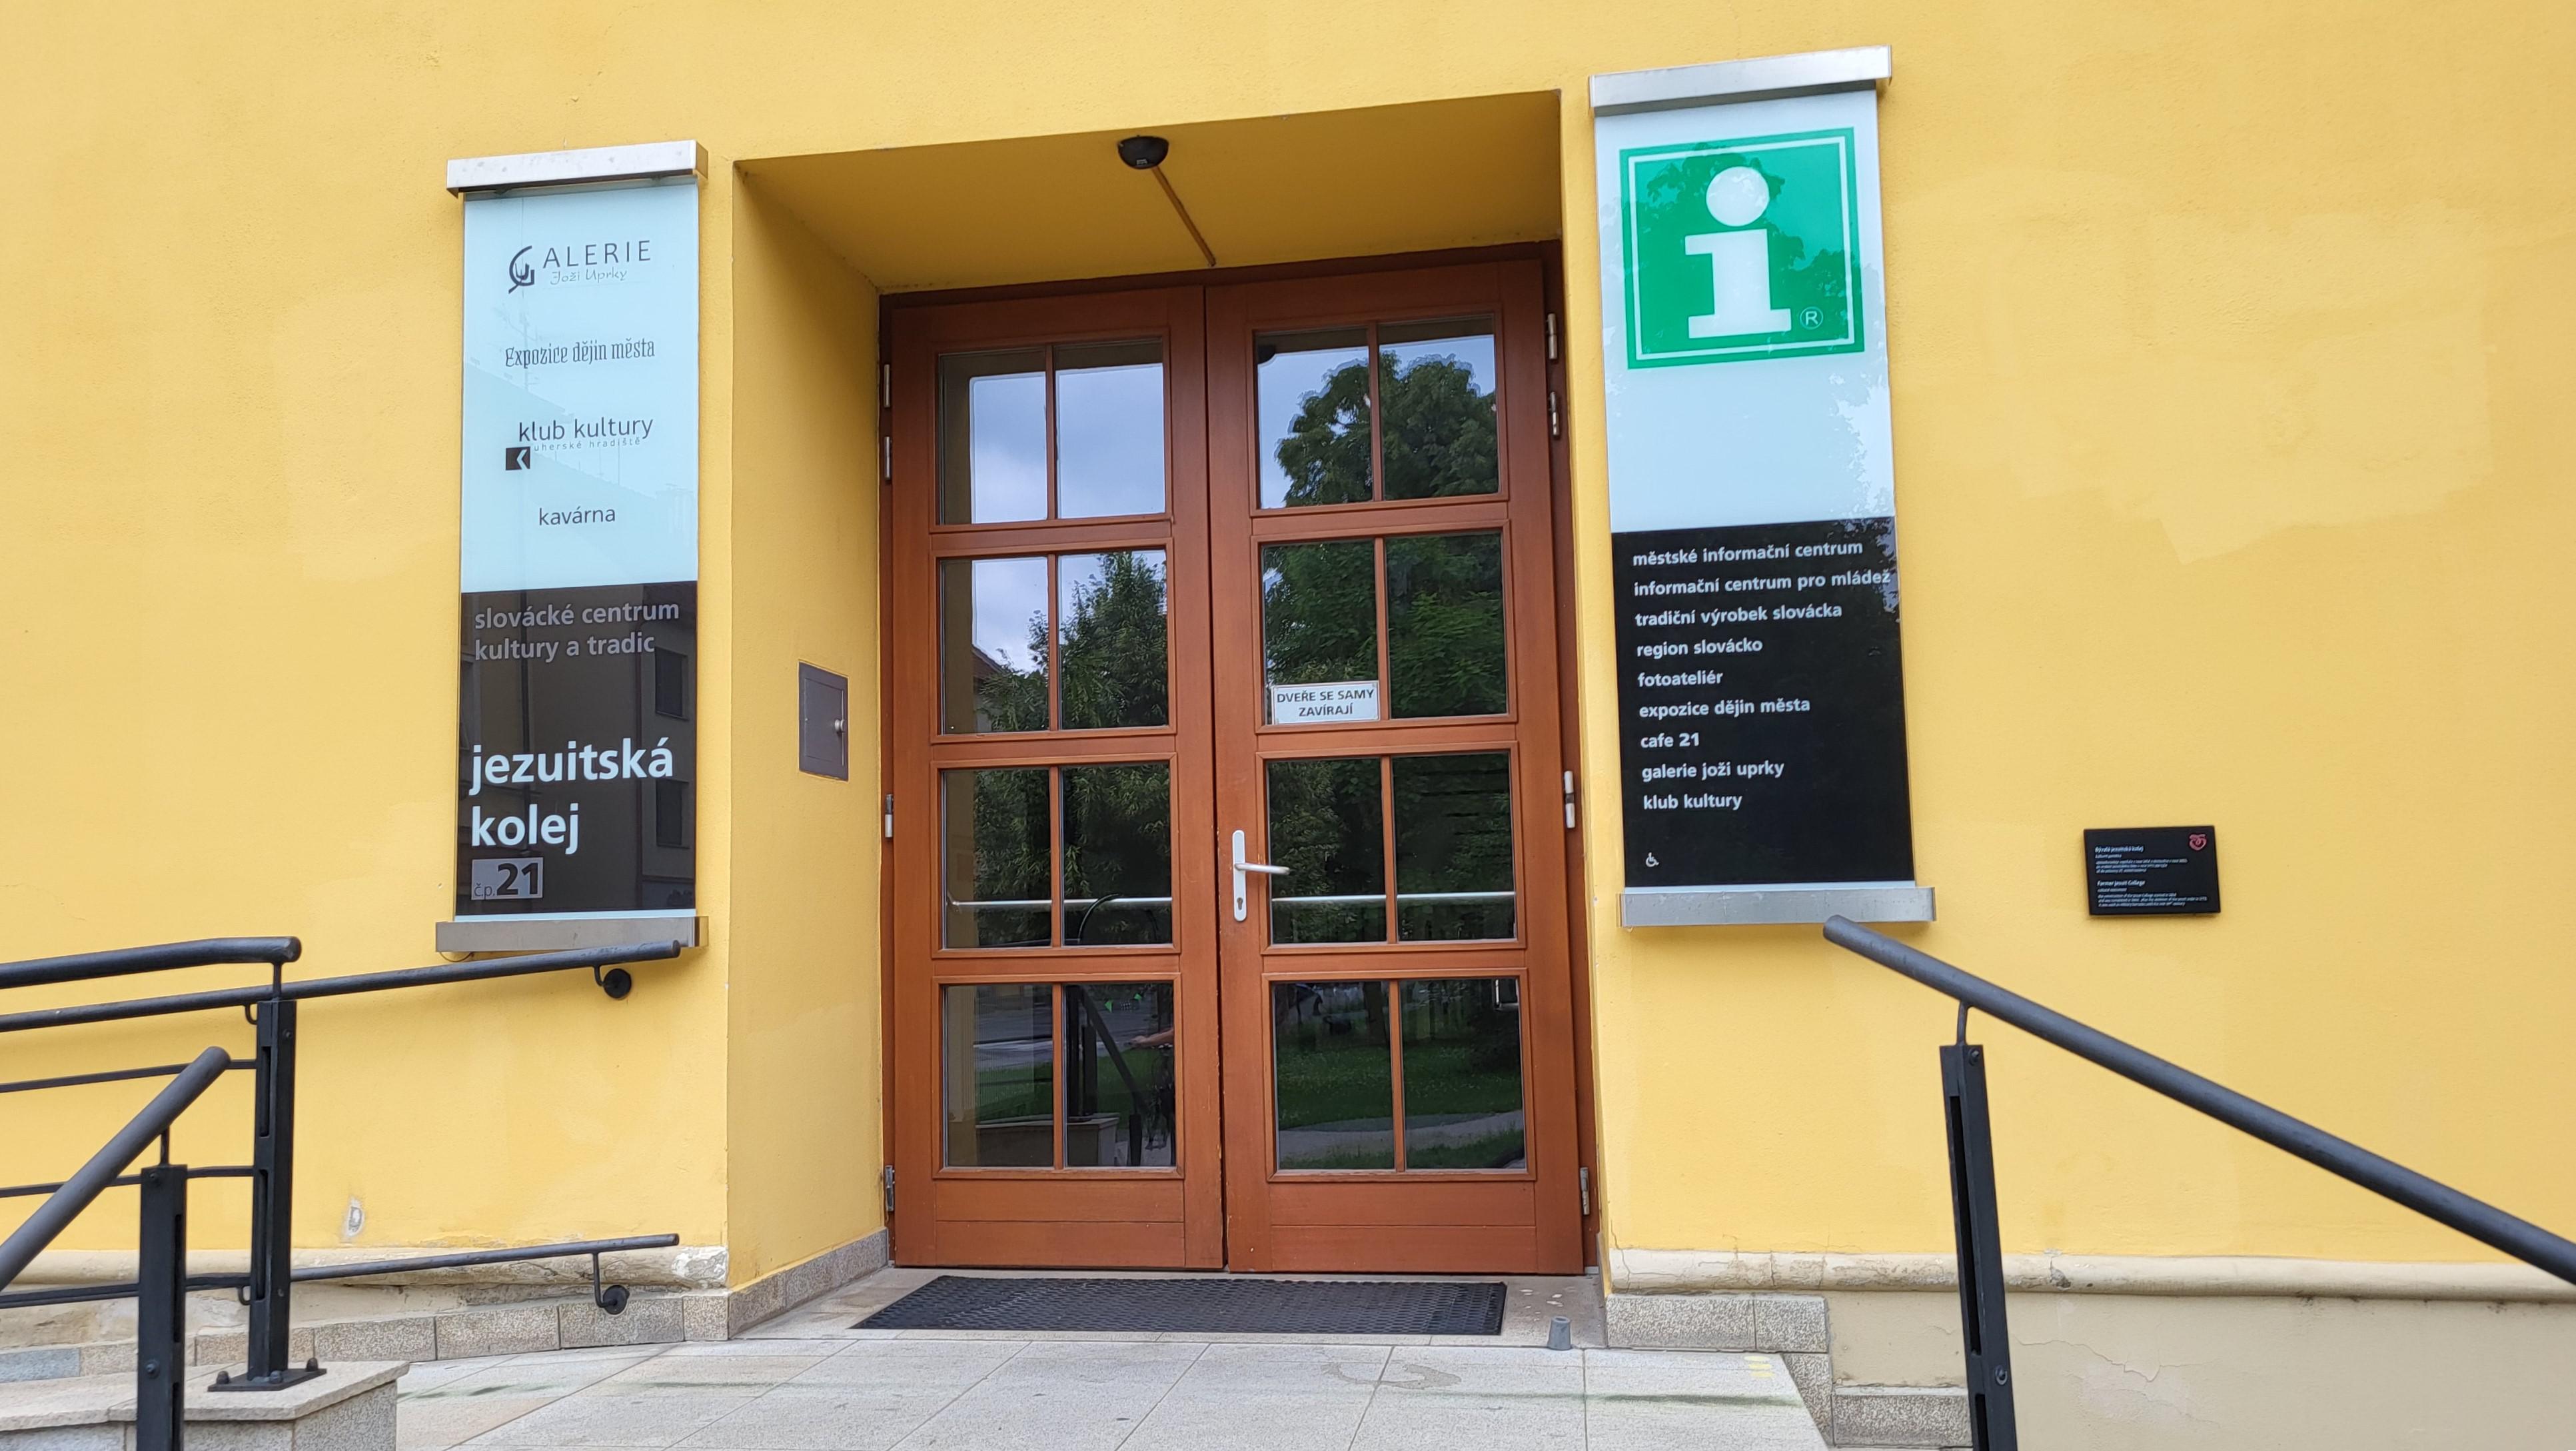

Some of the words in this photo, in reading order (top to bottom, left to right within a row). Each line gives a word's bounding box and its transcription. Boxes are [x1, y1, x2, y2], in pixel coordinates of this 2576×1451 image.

[585, 267, 627, 283] Uprky
[505, 343, 568, 369] Expozice
[572, 340, 607, 365] dějin
[612, 338, 655, 360] města
[519, 421, 566, 442] klub
[574, 417, 654, 439] kultury
[534, 441, 582, 451] uherské
[589, 437, 641, 449] hradiště
[539, 506, 616, 526] kavárna
[1632, 549, 1698, 567] městské
[1703, 542, 1790, 563] informační
[1795, 543, 1863, 558] centrum
[1634, 579, 1720, 596] informační
[1724, 576, 1792, 591] centrum
[1797, 573, 1826, 591] pro
[1831, 569, 1890, 587] mládež
[474, 604, 574, 629] slovácké
[582, 603, 680, 625] centrum
[1635, 610, 1696, 626] tradiční
[1700, 606, 1768, 626] výrobek
[1772, 604, 1842, 621] slovácka
[475, 638, 558, 663] kultury
[566, 642, 580, 656] a
[587, 631, 655, 655] tradic
[1636, 641, 1688, 659] region
[1694, 639, 1763, 654] slovácko
[1637, 671, 1723, 687] fotoateliér
[1277, 690, 1315, 703] DVEŘE
[1320, 691, 1334, 701] SE
[1338, 689, 1374, 699] SAMY
[1299, 703, 1353, 717] ZAVÍRAJÍ
[1639, 702, 1709, 719] expozice
[1714, 700, 1754, 718] dějin
[1760, 698, 1810, 713] města
[1640, 734, 1674, 748] cafe
[1679, 733, 1700, 746] 21
[468, 737, 674, 796] jezuitská
[1642, 764, 1696, 782] galerie
[1701, 762, 1731, 780] joži
[1736, 760, 1784, 778] uprky
[1643, 794, 1678, 810] klub
[1684, 792, 1742, 810] kultury
[471, 802, 580, 854] kolej
[496, 862, 539, 896] 21
